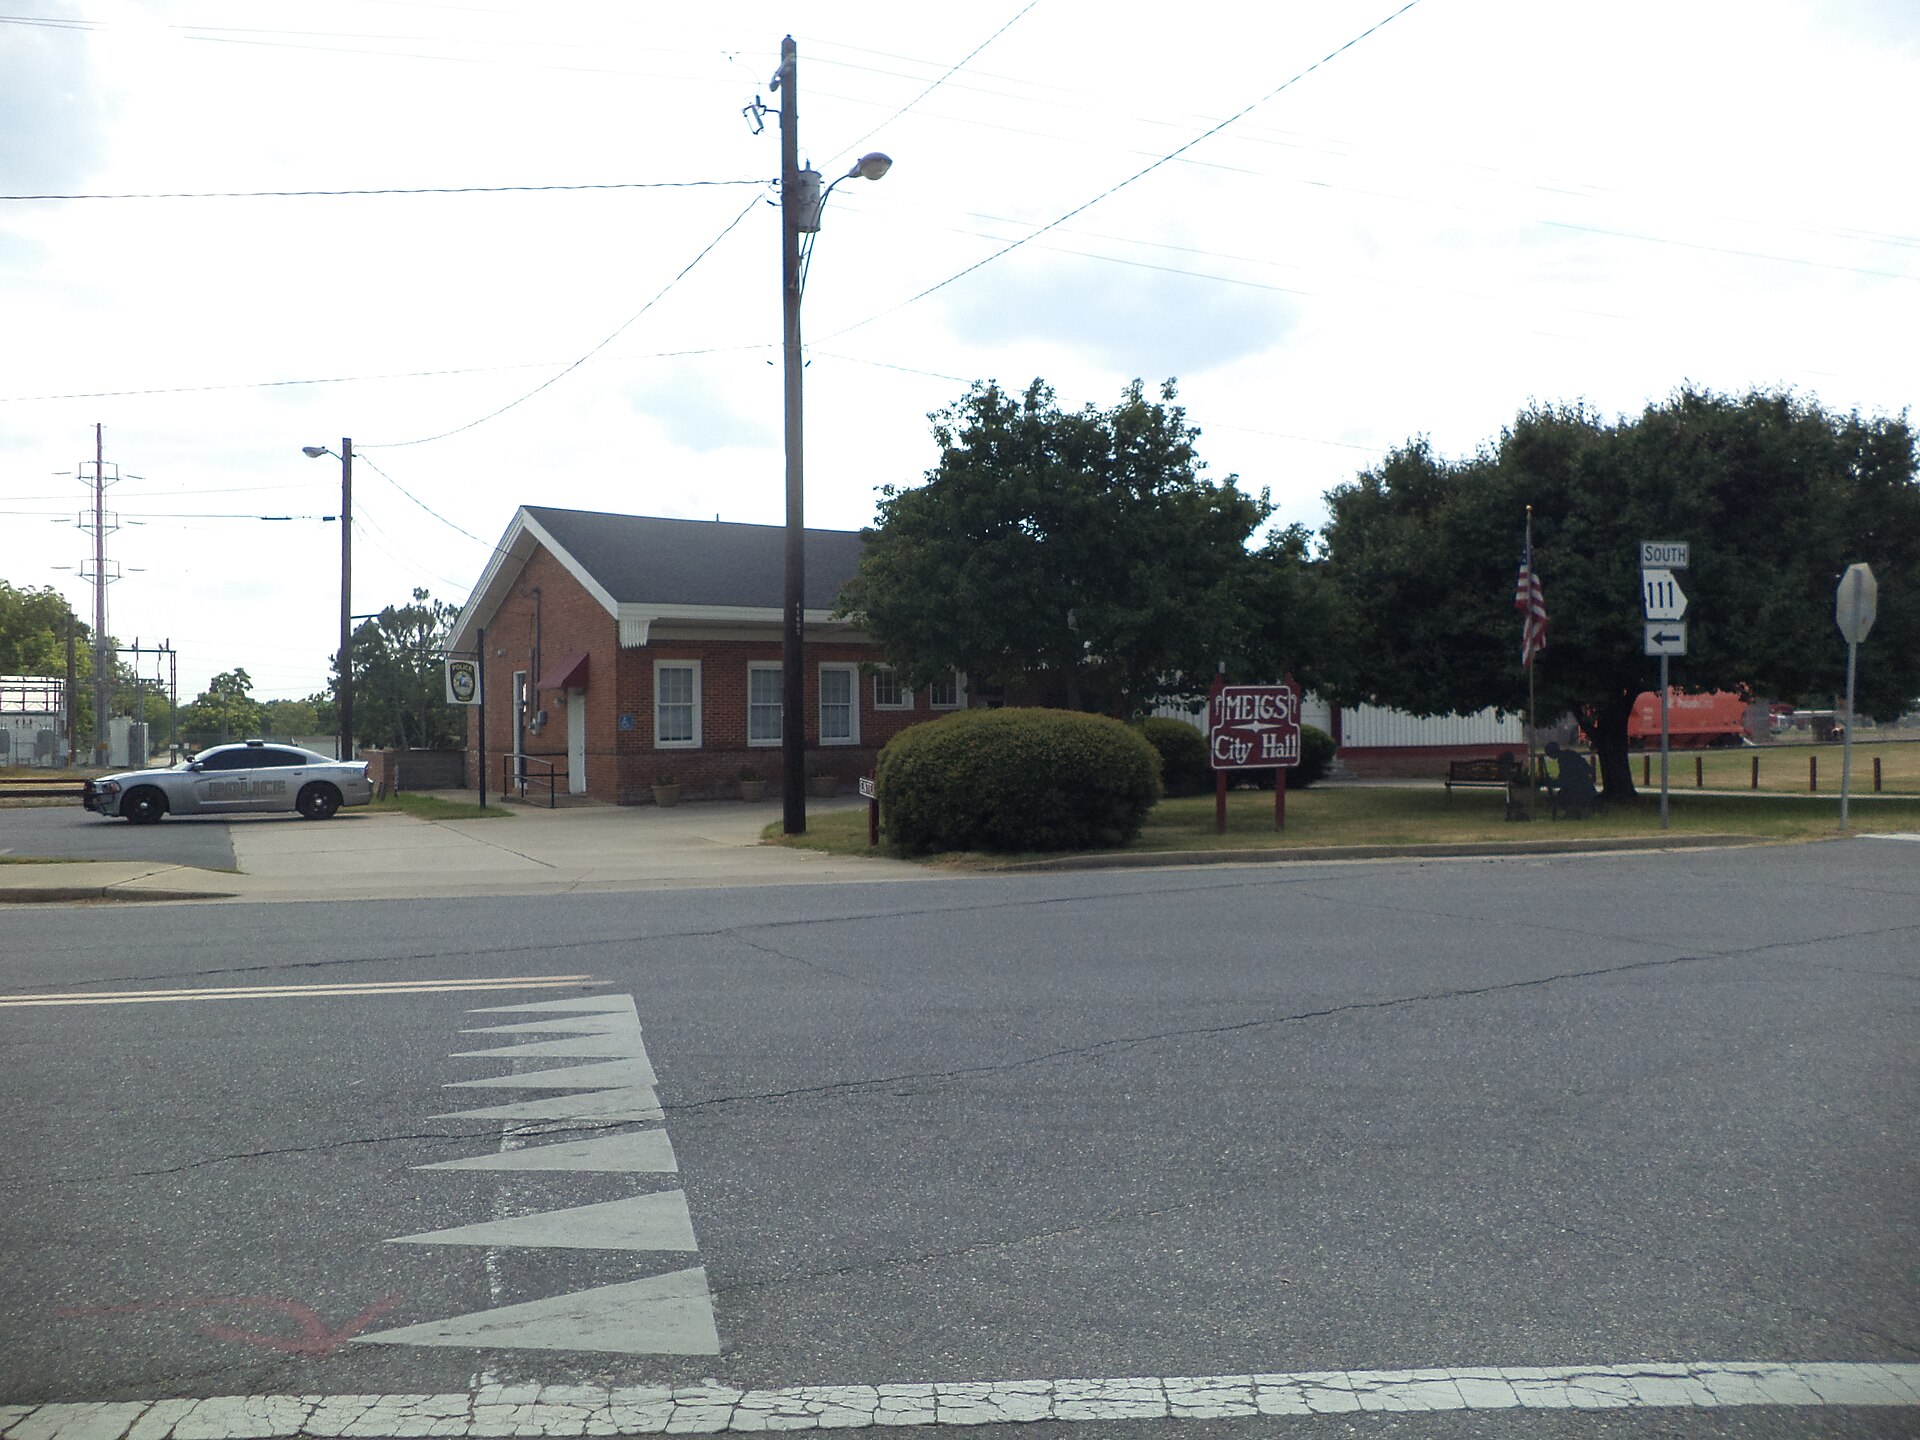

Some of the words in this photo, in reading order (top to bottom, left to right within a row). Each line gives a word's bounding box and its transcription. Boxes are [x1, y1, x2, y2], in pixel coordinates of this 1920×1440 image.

[1645, 546, 1686, 561] SOUTH
[1648, 581, 1673, 608] 111
[452, 663, 474, 672] POLICE
[1226, 695, 1288, 720] MEIGS
[1215, 735, 1254, 764] City
[1262, 733, 1297, 758] Hall
[208, 780, 286, 798] POLICE
